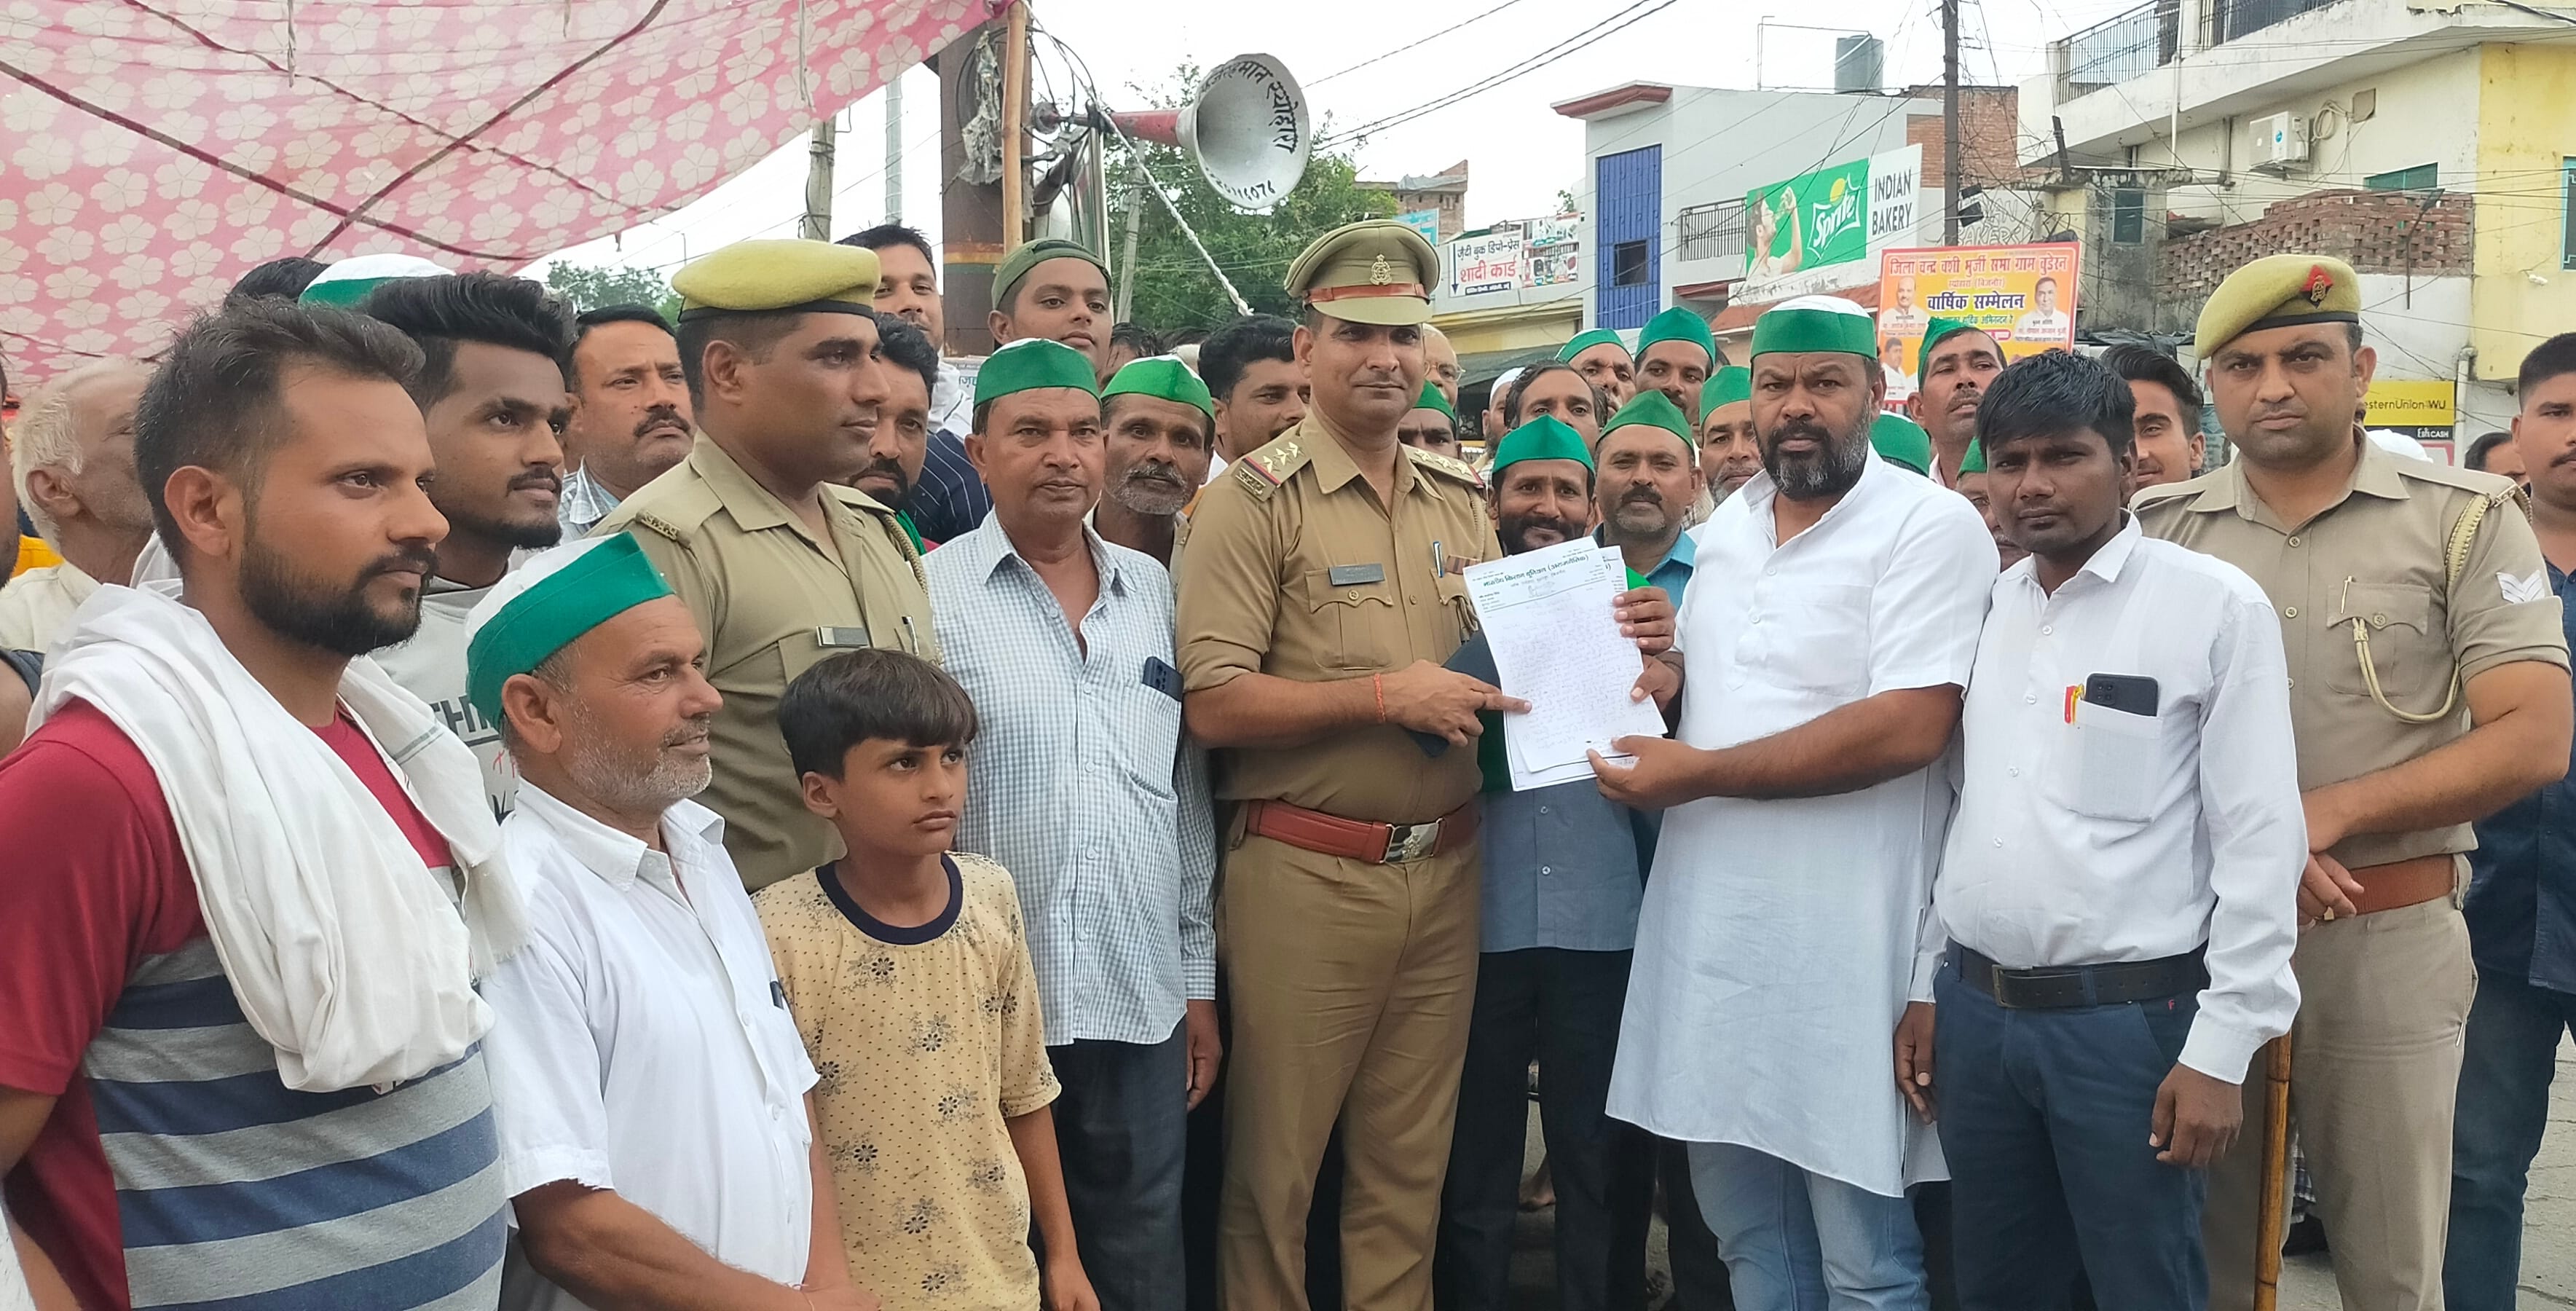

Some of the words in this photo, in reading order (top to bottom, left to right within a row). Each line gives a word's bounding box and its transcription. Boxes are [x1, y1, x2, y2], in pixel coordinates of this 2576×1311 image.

[1874, 169, 1911, 202] INDIAN
[1815, 191, 1856, 247] Sprite
[1872, 202, 1913, 236] BAKERY
[1460, 259, 1486, 282] शादी
[1490, 254, 1517, 277] कार्ड
[1890, 258, 1915, 274] जिला
[1919, 261, 1937, 273] चन्द्र
[1941, 256, 1960, 273] वंशी
[2015, 257, 2036, 271] ग्राम
[1928, 291, 1969, 310] वार्षिक
[1974, 291, 2025, 309] सम्मेलन
[2364, 399, 2425, 409] esternUnion
